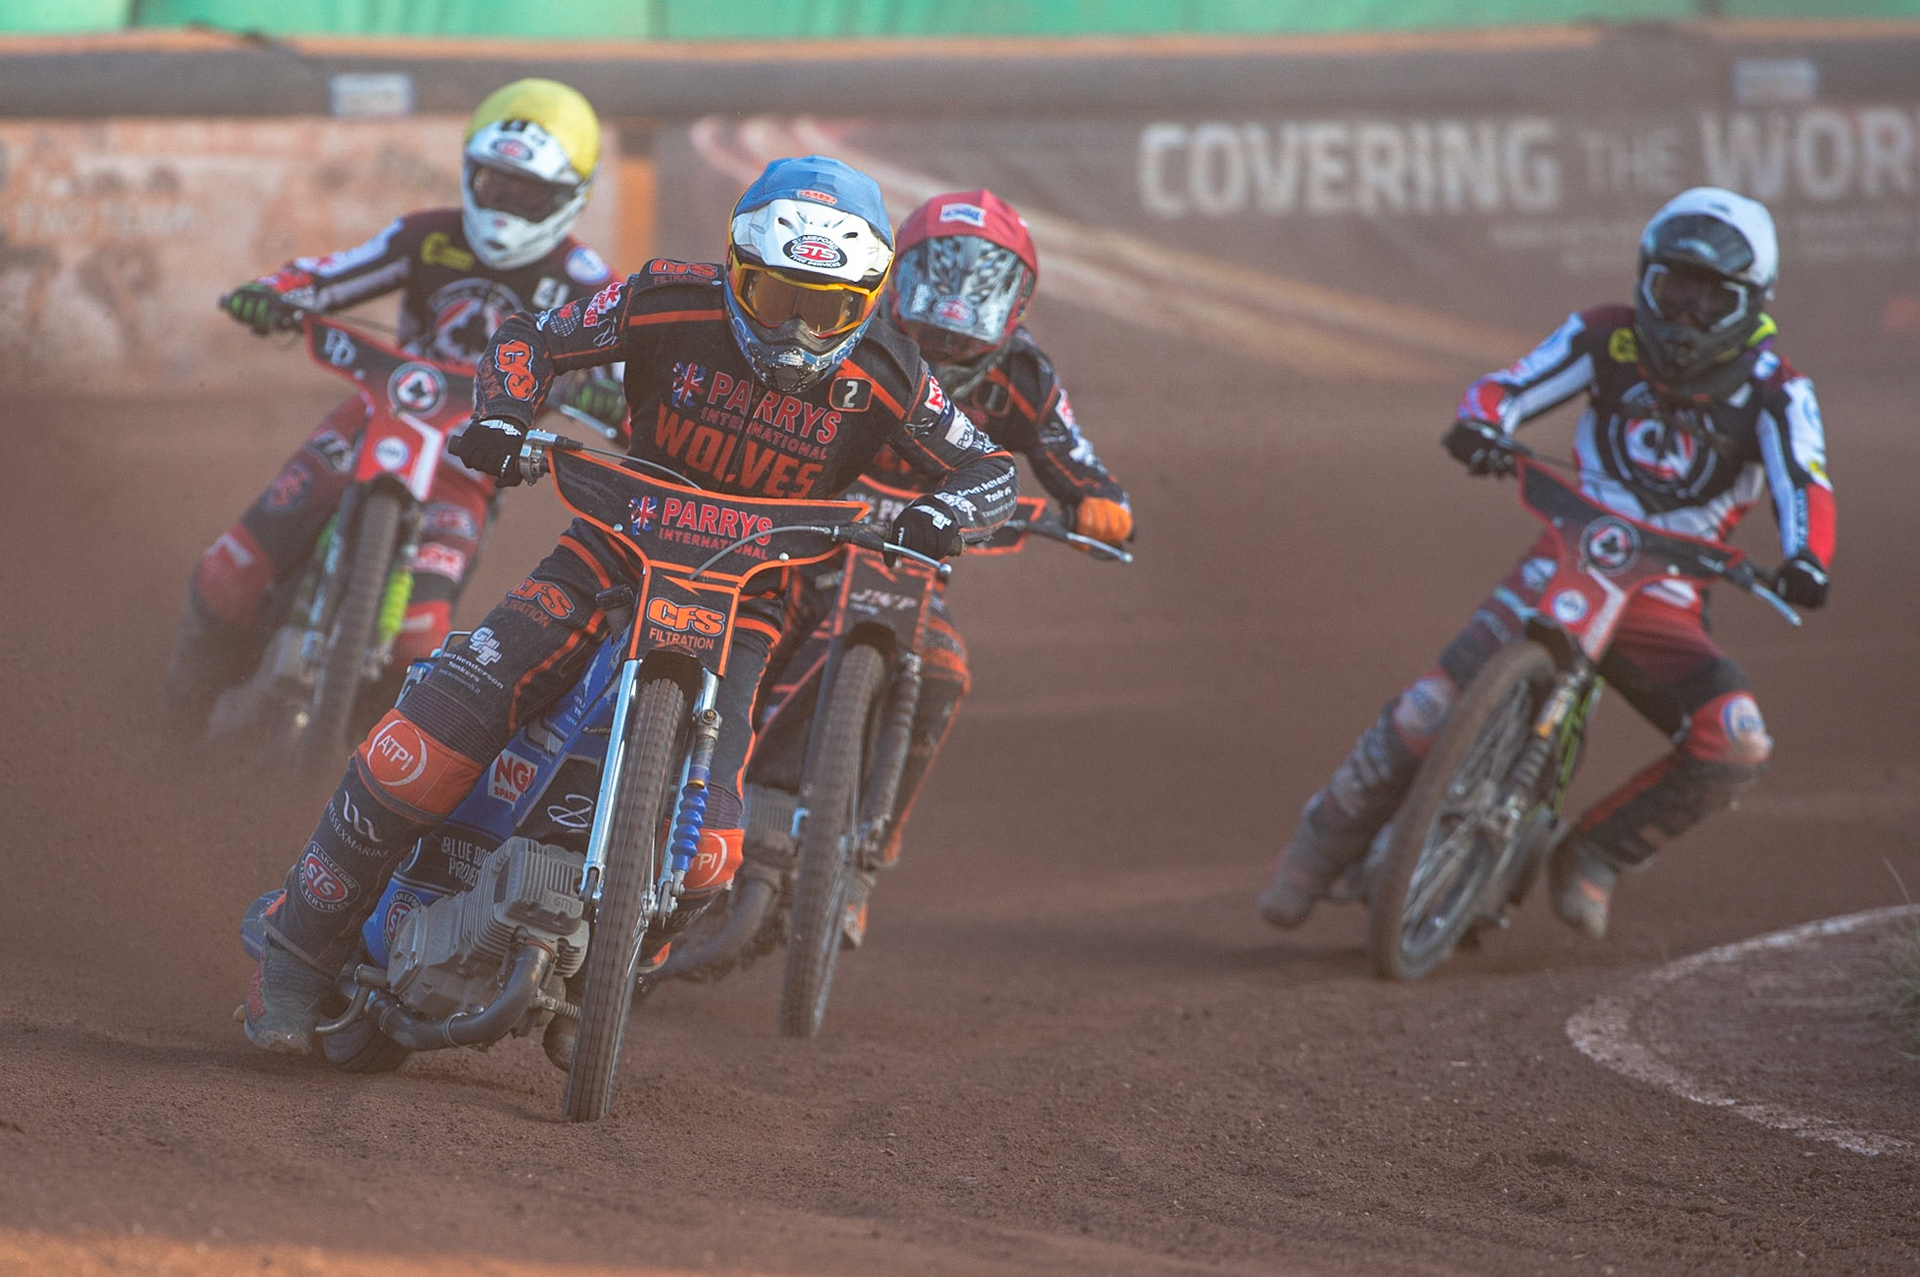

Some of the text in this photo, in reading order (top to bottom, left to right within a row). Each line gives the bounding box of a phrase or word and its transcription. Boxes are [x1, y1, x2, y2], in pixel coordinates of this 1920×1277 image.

[1138, 117, 1561, 216] COVERING
[1579, 132, 1684, 190] THE
[794, 244, 835, 260] STS
[654, 274, 711, 286] FILTRATION
[707, 371, 842, 445] PARRYS
[842, 380, 859, 408] 2
[661, 497, 773, 546] PARRYS
[647, 597, 725, 636] CFS
[649, 627, 714, 650] FILTRATION
[378, 734, 414, 771] ATPI
[441, 836, 473, 862] BLUE
[306, 862, 337, 897] STS
[388, 908, 407, 933] ST
